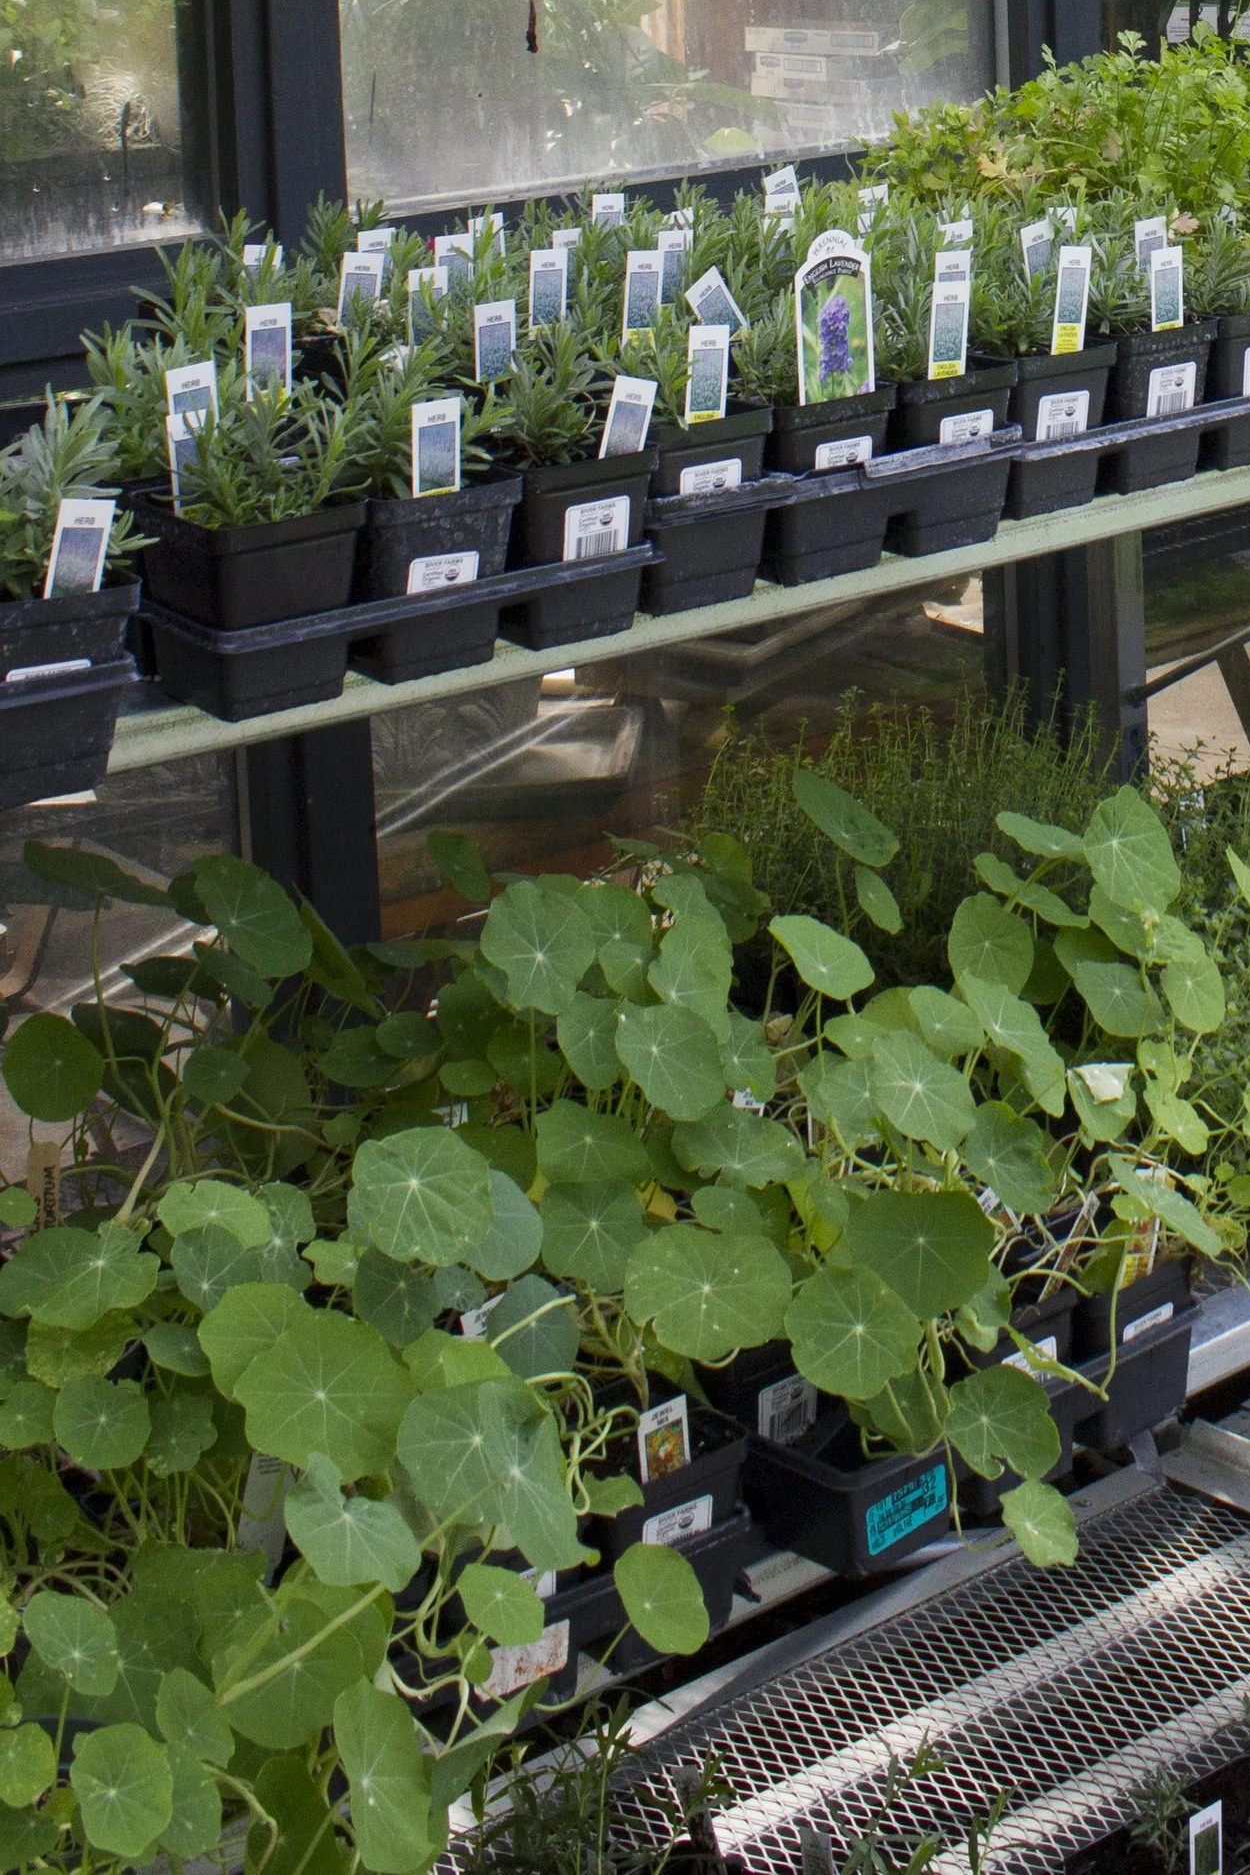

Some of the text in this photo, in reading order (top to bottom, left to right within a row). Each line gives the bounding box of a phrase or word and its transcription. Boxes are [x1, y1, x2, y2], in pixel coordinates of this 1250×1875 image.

[427, 413, 447, 423] HERB
[74, 516, 95, 525] HERB
[651, 1406, 673, 1421] JEWEL
[657, 1417, 669, 1426] MIX
